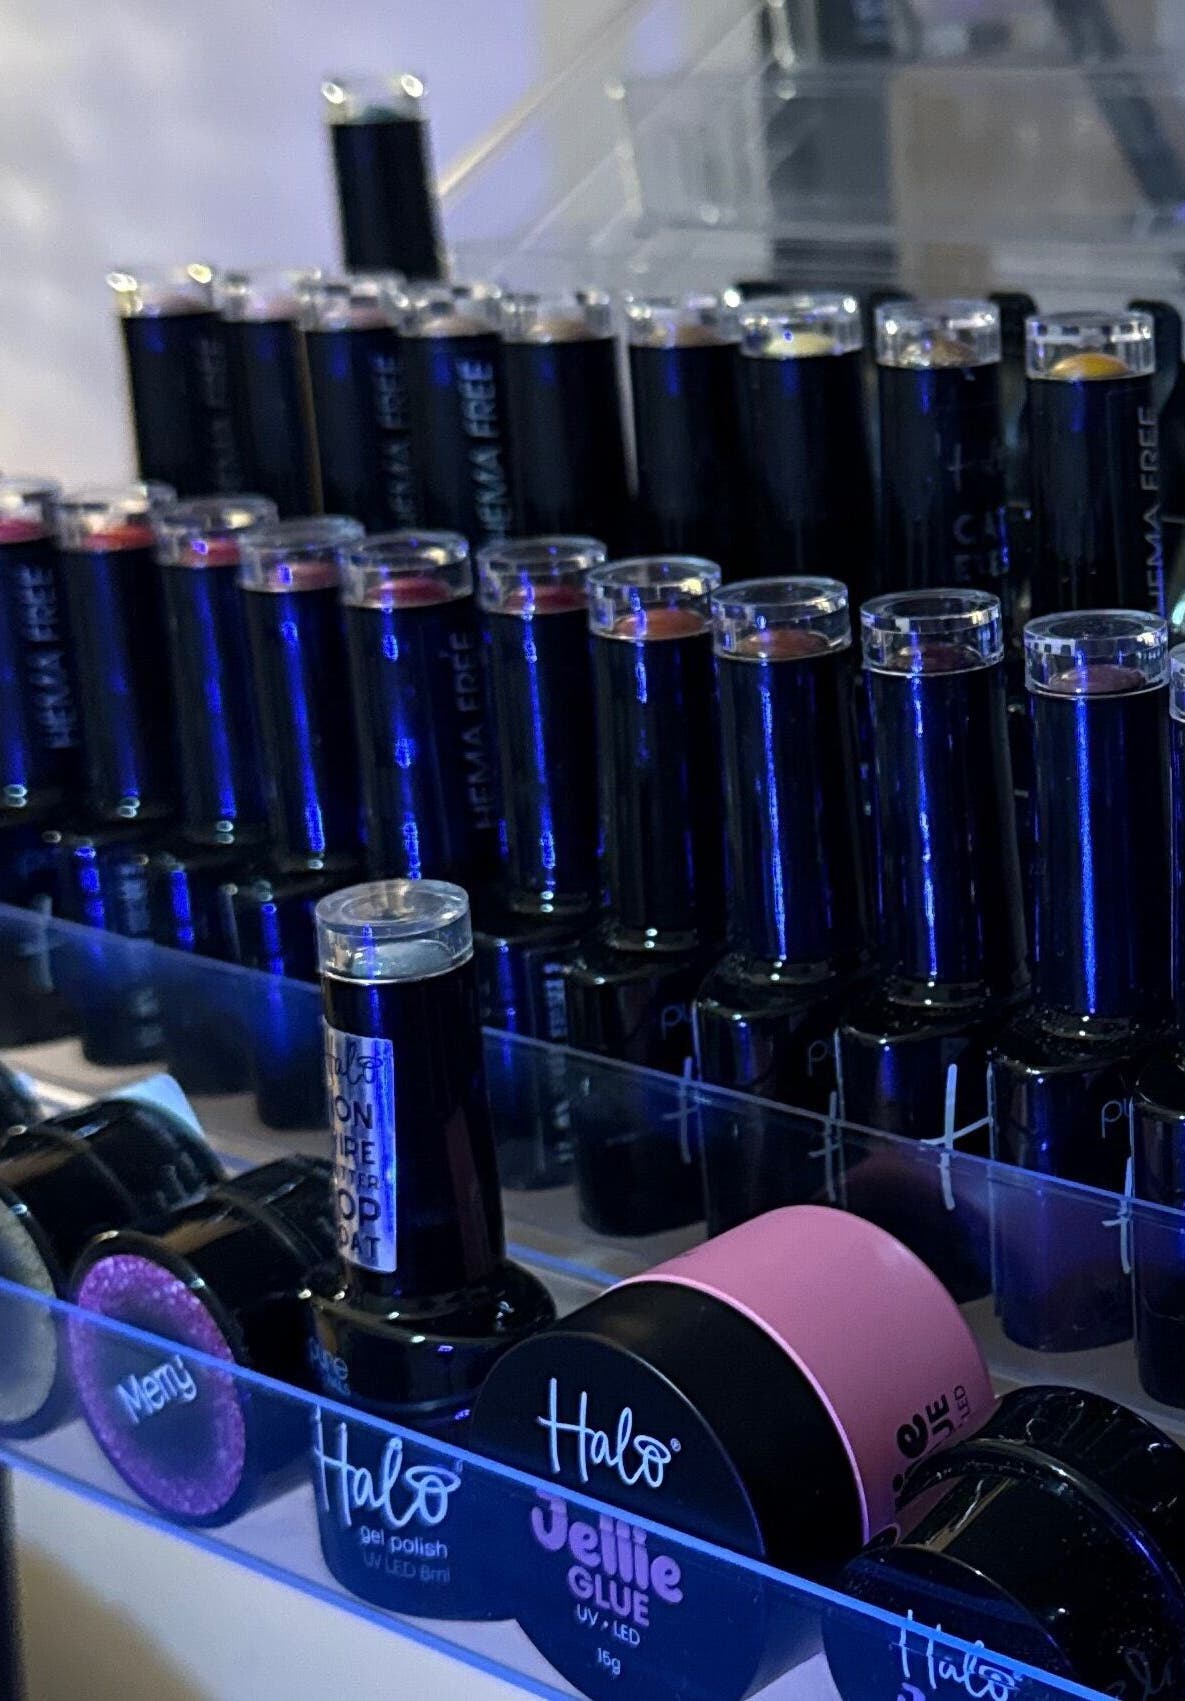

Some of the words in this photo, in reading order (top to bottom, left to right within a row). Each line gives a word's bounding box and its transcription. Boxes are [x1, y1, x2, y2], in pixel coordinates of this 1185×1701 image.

[1137, 406, 1160, 491] FREE
[335, 1095, 374, 1130] ON
[338, 1188, 381, 1227] OP
[338, 1223, 382, 1258] OAT
[115, 1354, 198, 1424] Merry
[535, 1377, 672, 1489] Halo
[314, 1404, 462, 1529] Halo
[360, 1524, 385, 1546] gel
[390, 1533, 449, 1560] polish
[531, 1488, 684, 1604] Jellie
[567, 1564, 651, 1628] GLUE
[576, 1603, 599, 1627] UV
[613, 1619, 641, 1647] LED
[597, 1647, 621, 1676] 15g
